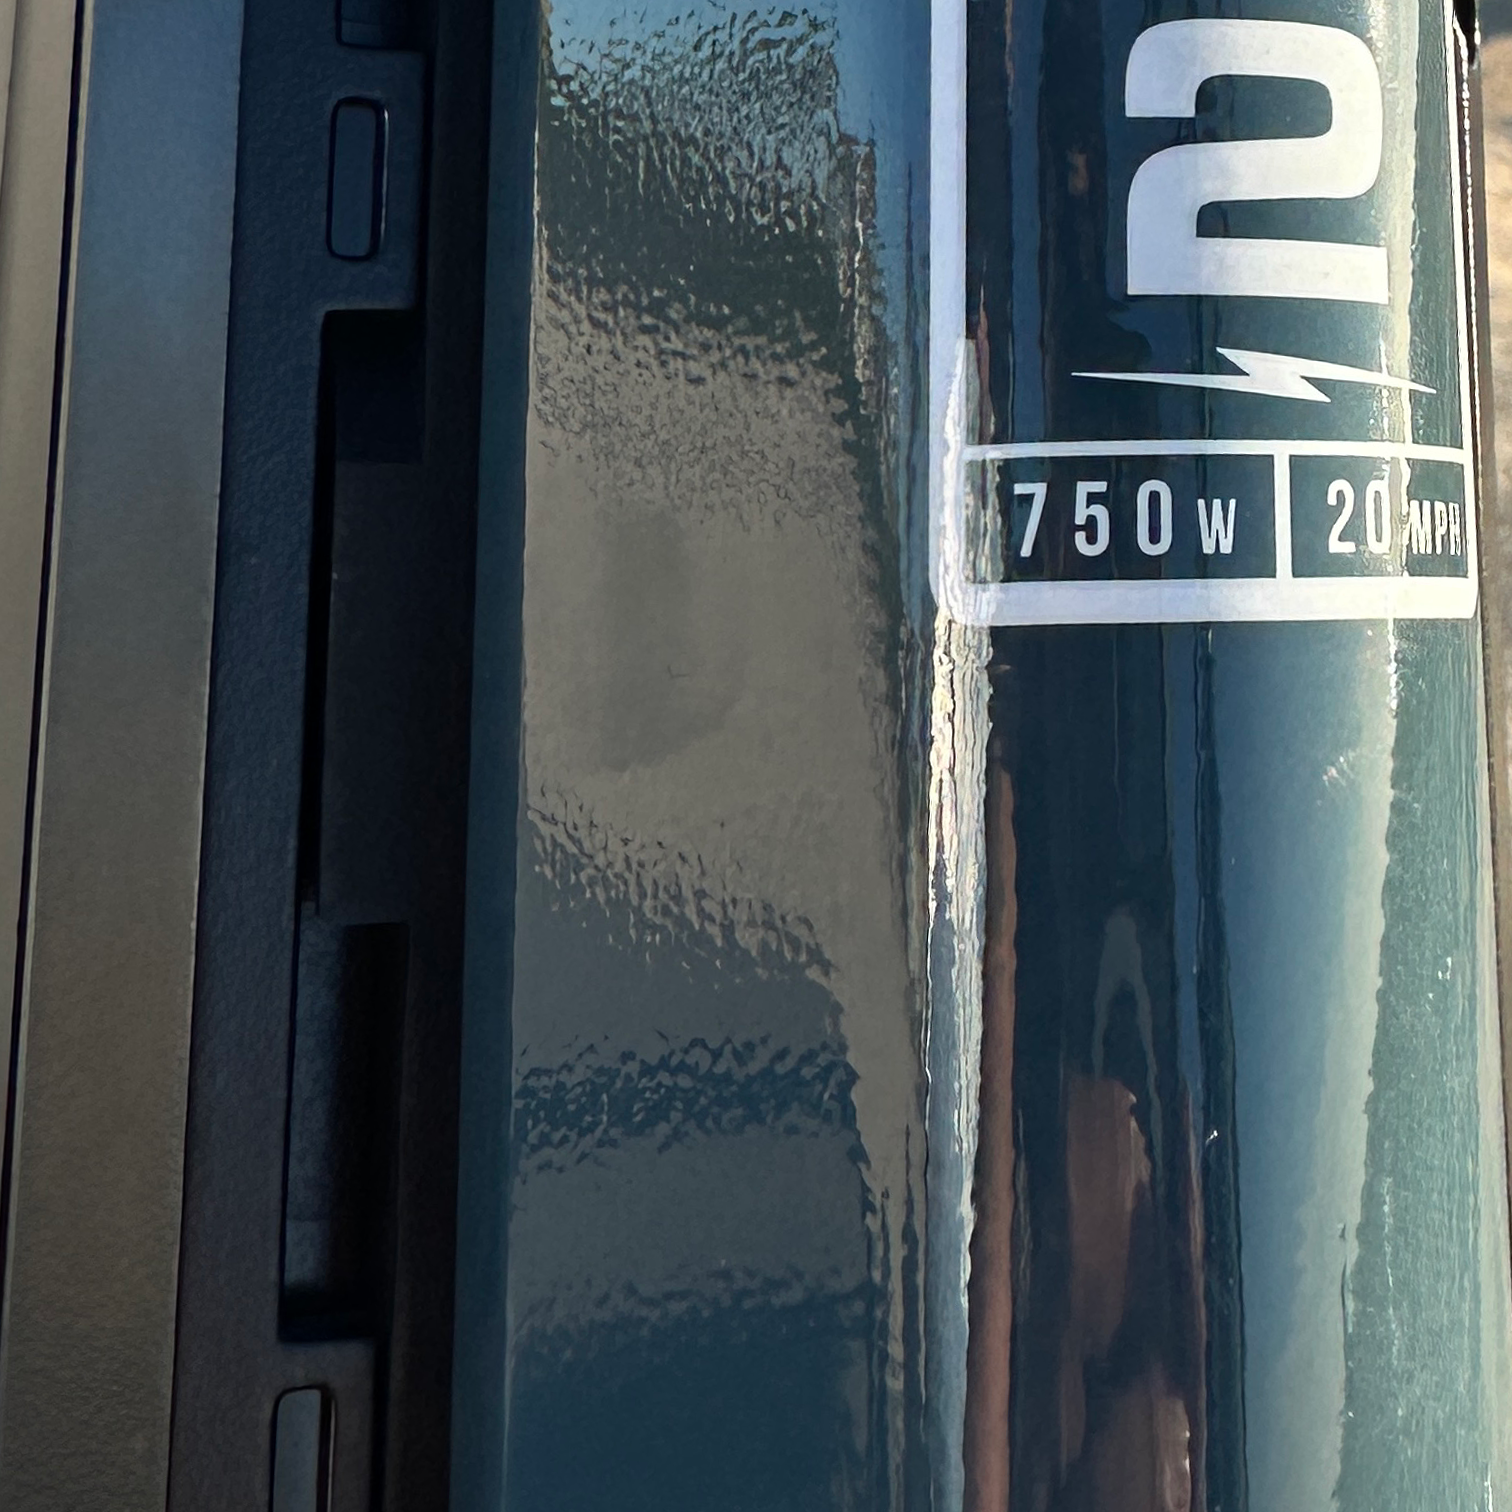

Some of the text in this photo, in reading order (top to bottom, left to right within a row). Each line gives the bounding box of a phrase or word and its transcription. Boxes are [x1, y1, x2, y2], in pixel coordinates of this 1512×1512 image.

[1125, 17, 1389, 305] 2
[1327, 479, 1462, 556] 20 MPH
